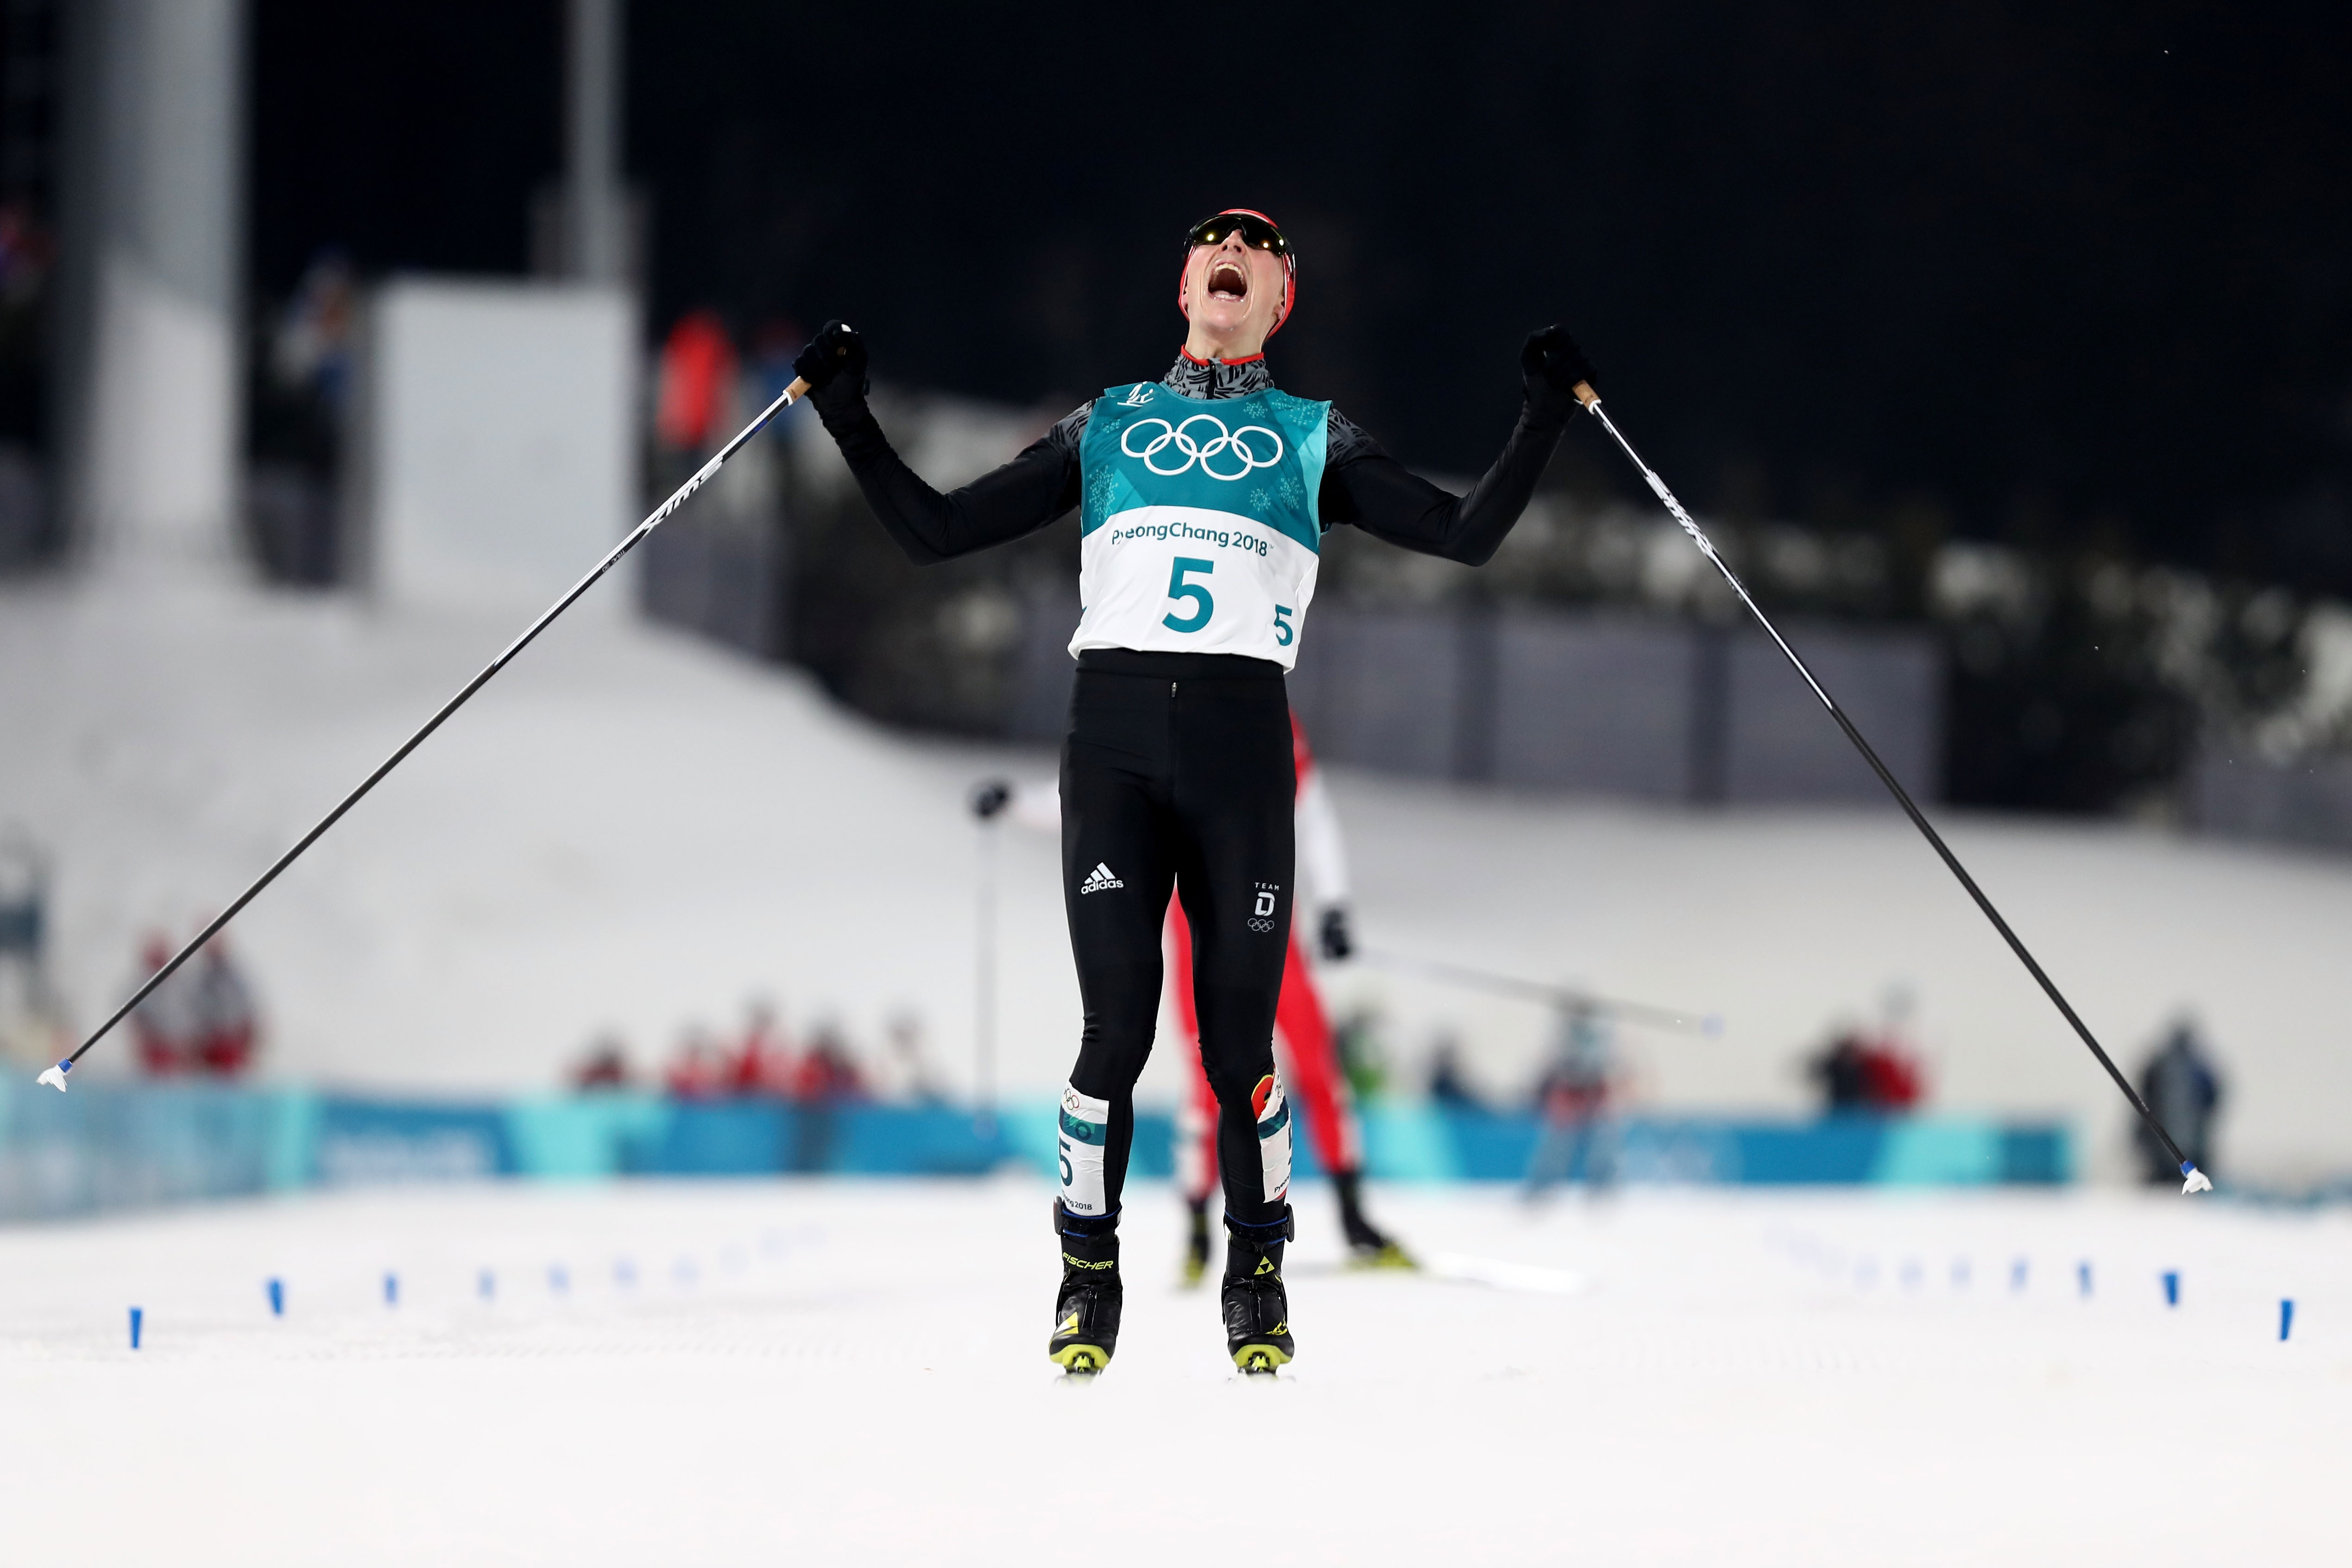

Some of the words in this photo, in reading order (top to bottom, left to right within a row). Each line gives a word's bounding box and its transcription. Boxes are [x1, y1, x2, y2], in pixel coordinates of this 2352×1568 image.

[1112, 522, 1230, 548] PyeongChang
[1231, 531, 1267, 557] 2018
[1161, 556, 1214, 633] 5
[1273, 604, 1294, 646] 5
[1081, 879, 1124, 894] adidas
[1255, 882, 1280, 891] TEAM
[1059, 1136, 1073, 1187] 5
[1074, 1201, 1092, 1210] 2018
[1062, 1252, 1114, 1270] FISCHER
